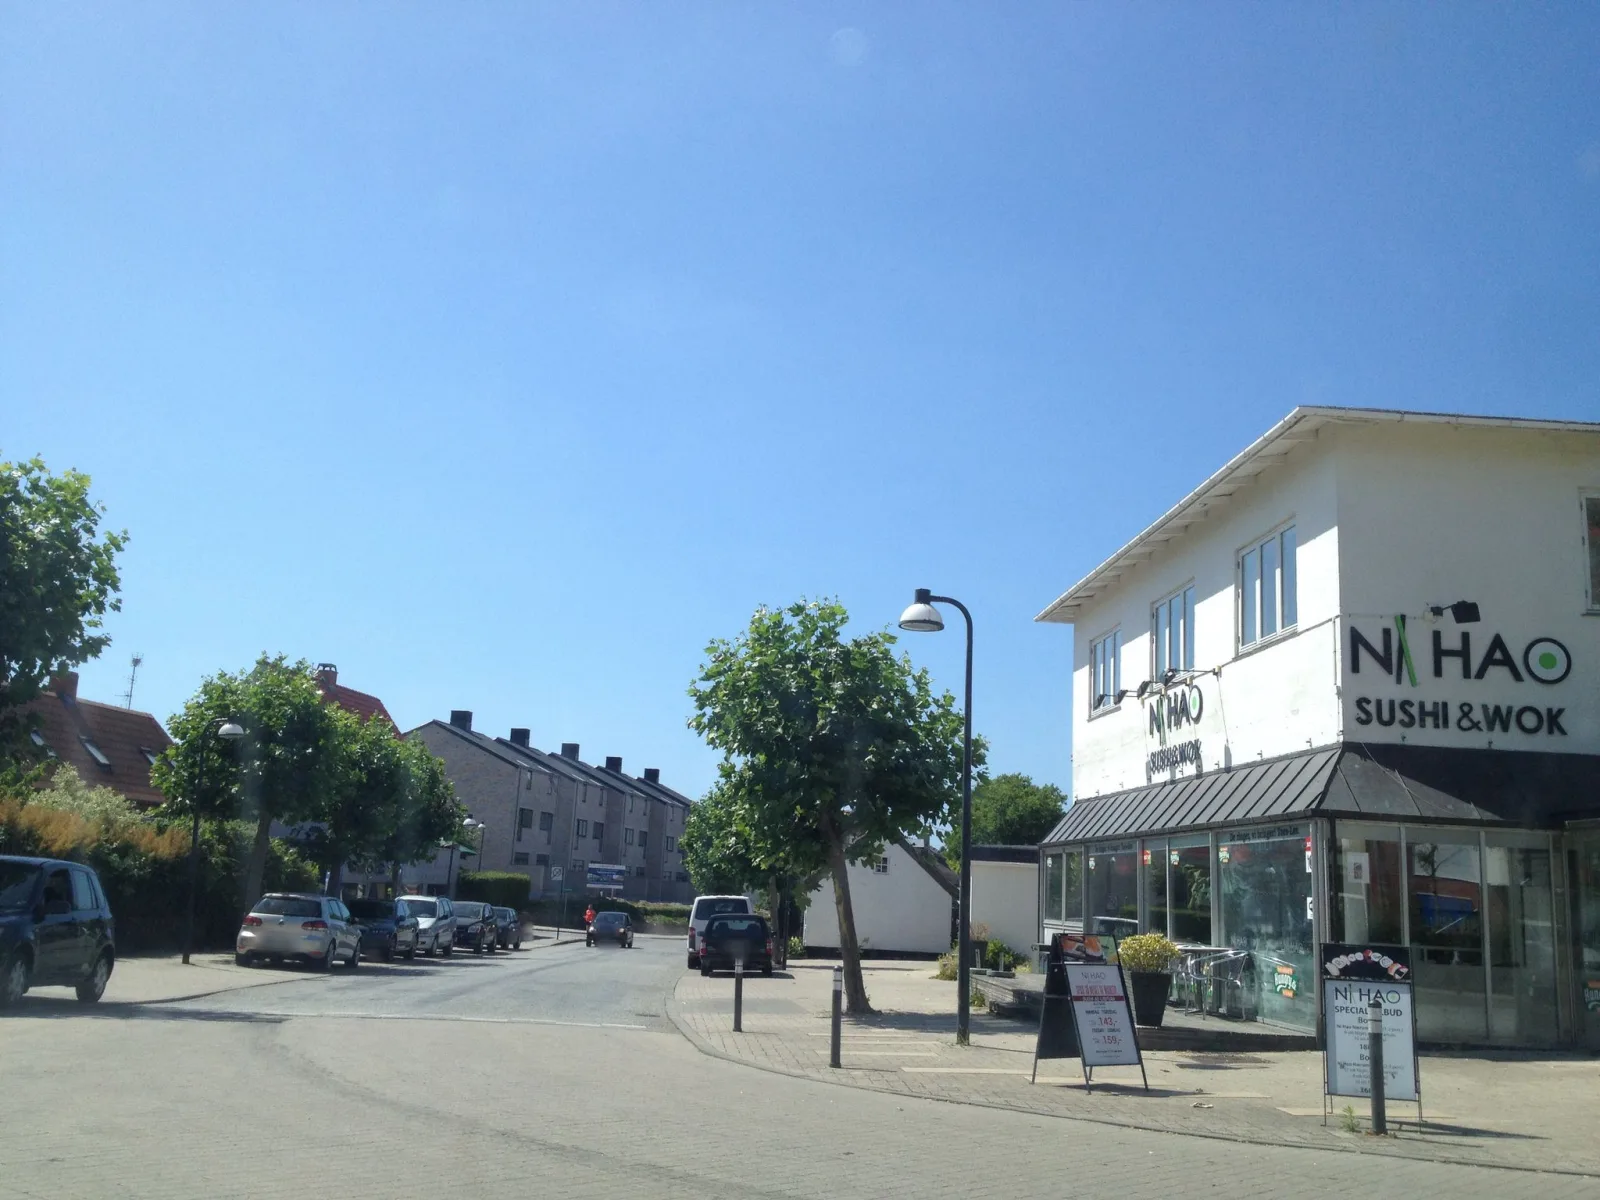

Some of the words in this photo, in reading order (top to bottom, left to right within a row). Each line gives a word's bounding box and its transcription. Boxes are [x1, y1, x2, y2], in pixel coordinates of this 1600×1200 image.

[1432, 630, 1572, 685] HAO
[1167, 685, 1203, 733] HAO
[1359, 987, 1401, 1004] HAO
